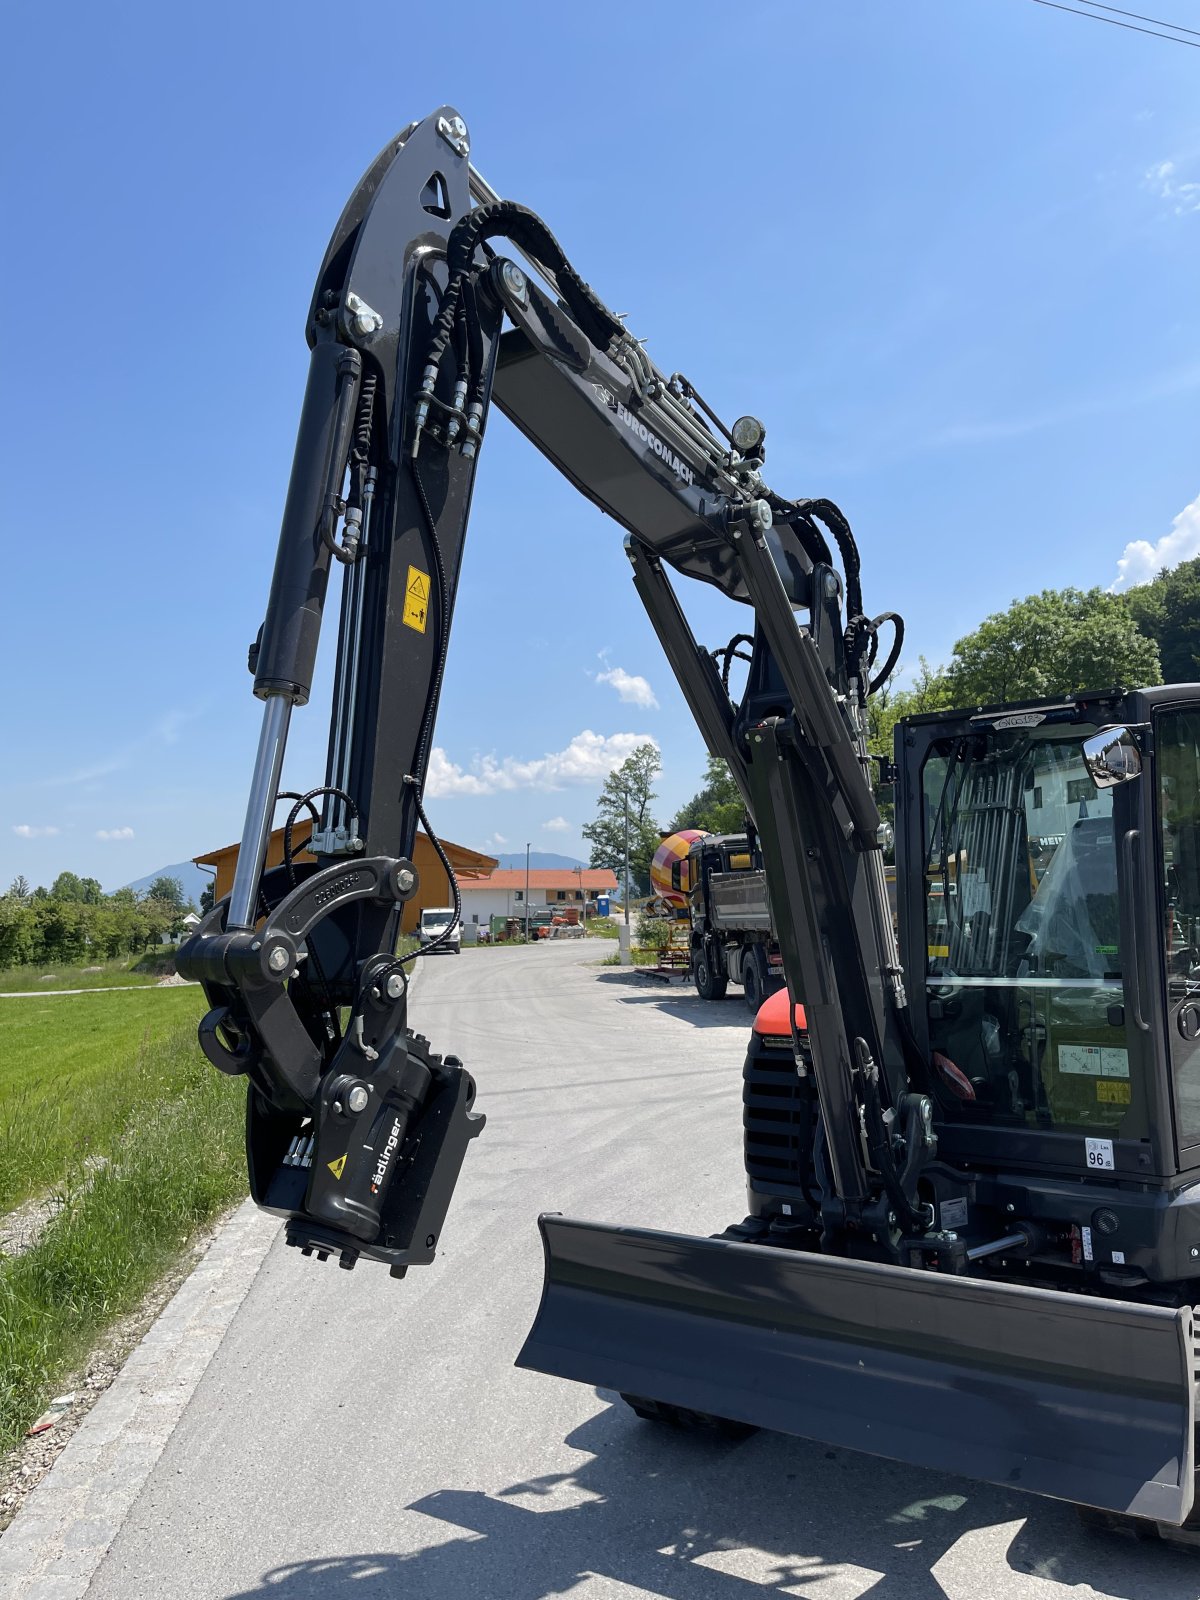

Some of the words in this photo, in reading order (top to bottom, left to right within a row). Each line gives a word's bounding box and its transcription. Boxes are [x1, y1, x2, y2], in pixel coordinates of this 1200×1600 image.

[616, 401, 694, 486] EUROCOMACH
[370, 1117, 401, 1194] rädlinger
[1089, 1151, 1104, 1166] 96
